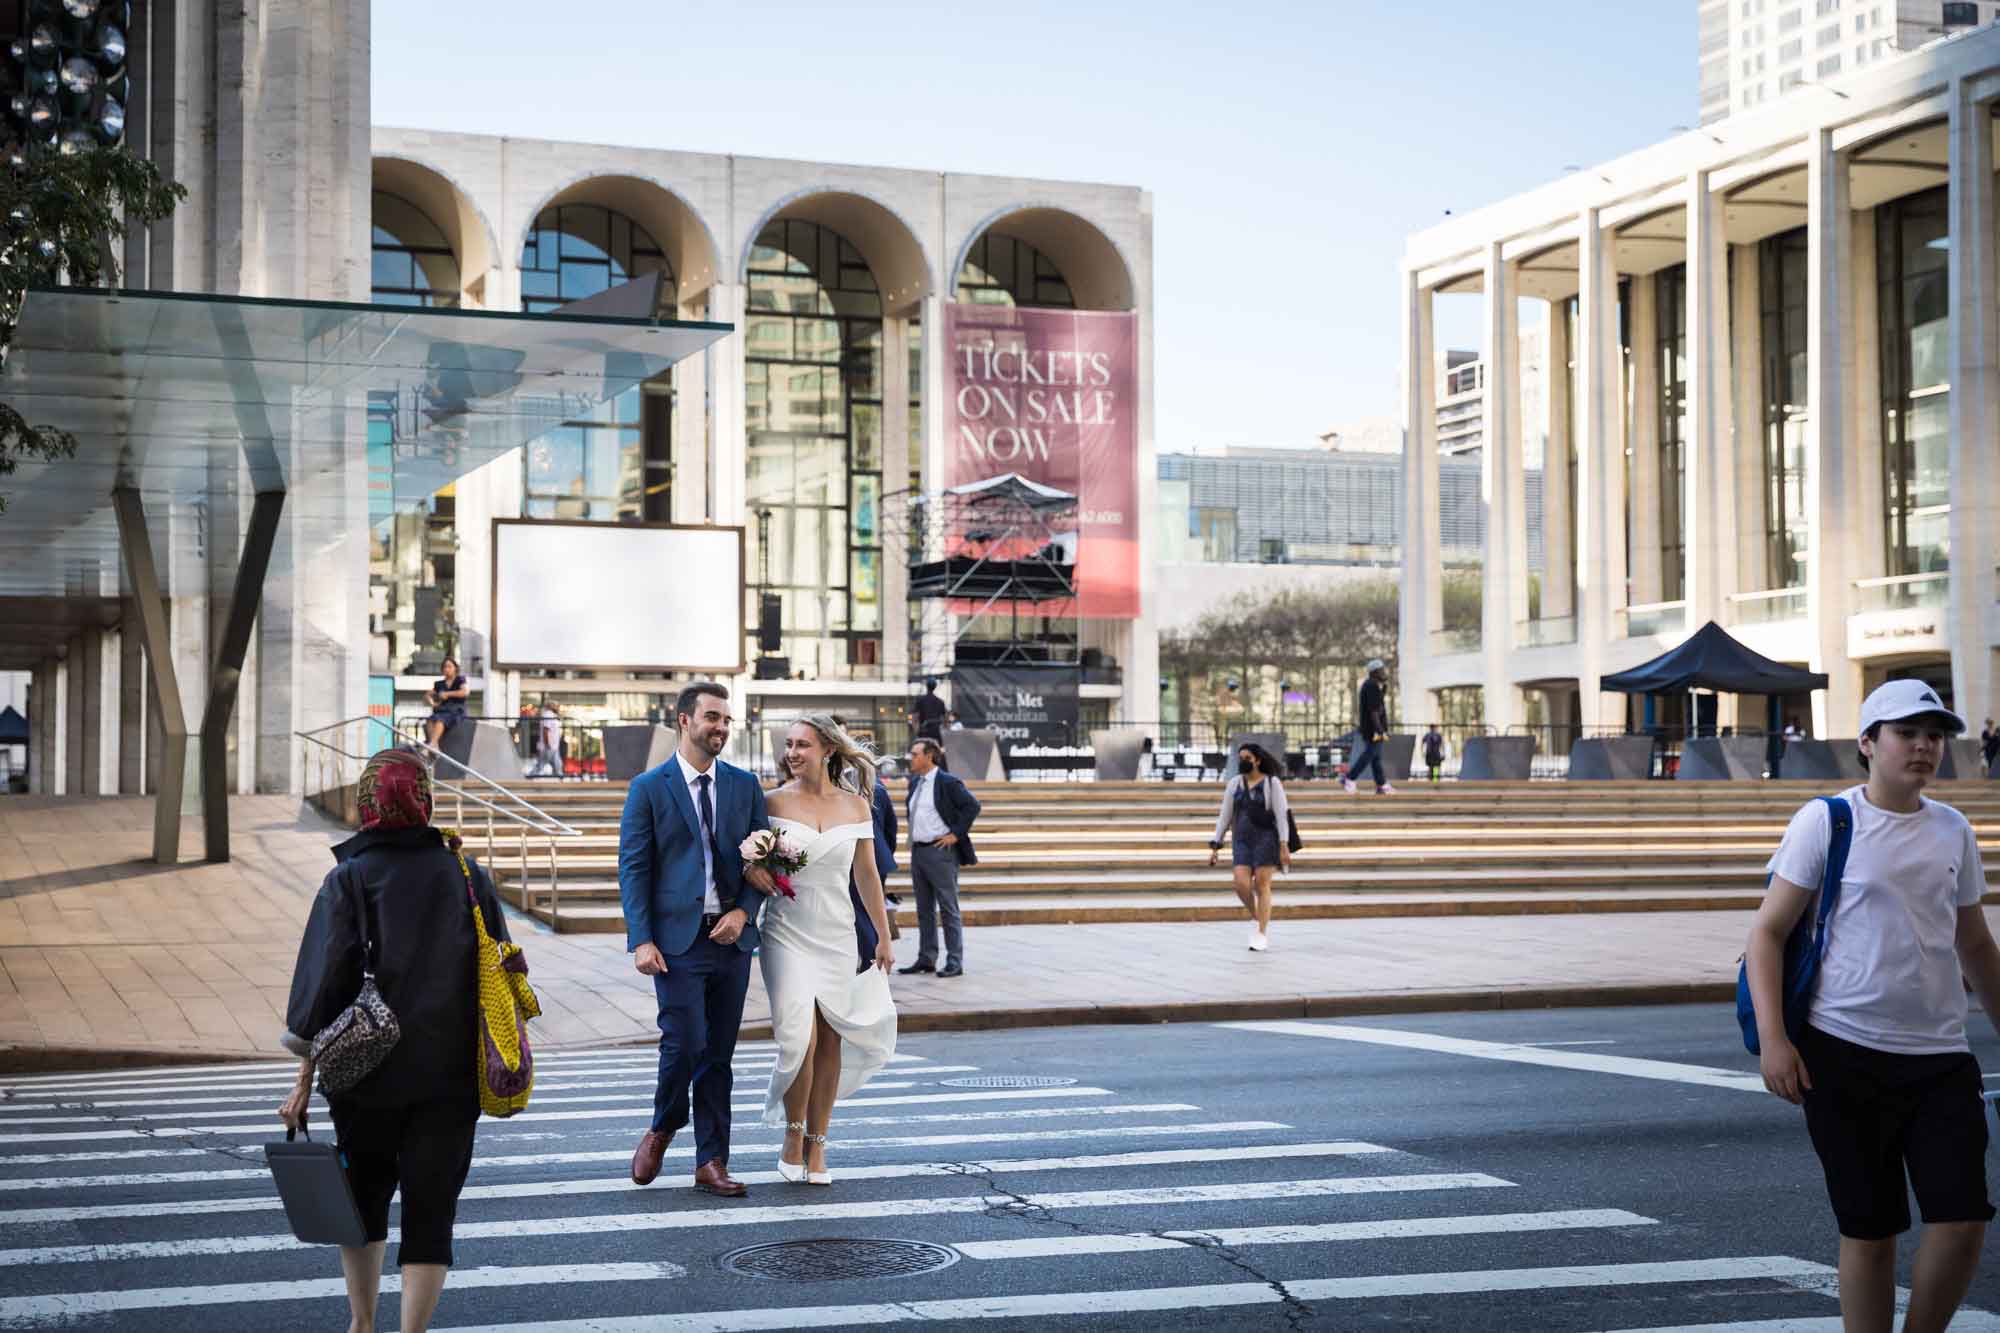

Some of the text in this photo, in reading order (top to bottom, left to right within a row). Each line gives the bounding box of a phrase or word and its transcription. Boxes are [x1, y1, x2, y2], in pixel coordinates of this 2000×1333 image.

[957, 342, 1110, 385] TICKETS
[957, 385, 1115, 424] ON SALE
[959, 425, 1055, 461] NOW
[985, 691, 1043, 708] The Met
[985, 723, 1029, 740] Opera
